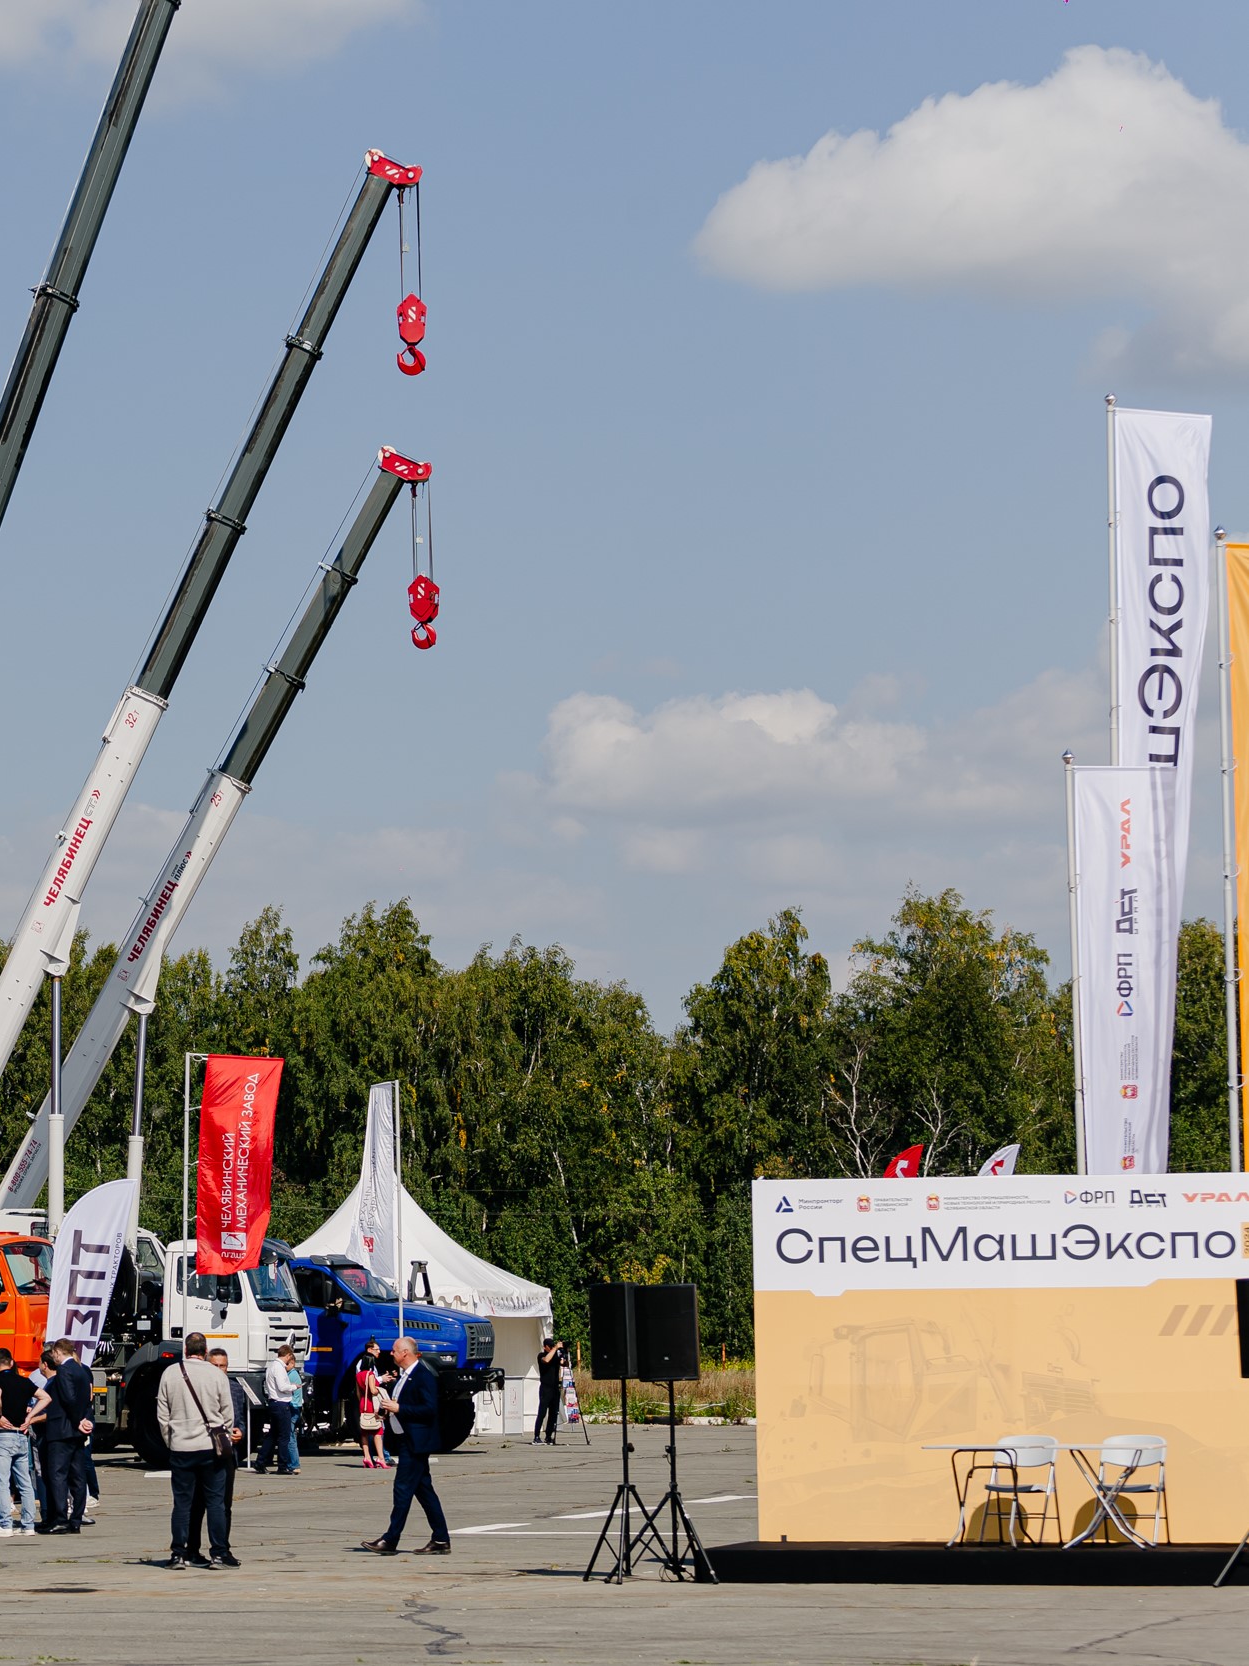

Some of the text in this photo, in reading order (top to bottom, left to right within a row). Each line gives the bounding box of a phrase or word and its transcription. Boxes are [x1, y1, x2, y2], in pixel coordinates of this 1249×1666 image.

[43, 817, 93, 907] ЧЕЛЯБИНЕЦ
[1120, 798, 1131, 869] УРАЛ
[127, 880, 179, 962] ЧЕЛЯБИНЕЦ
[1116, 953, 1134, 998] ФРП
[7, 1139, 38, 1193] 8-800-555-74-74
[221, 1132, 236, 1228] ЧЕЛЯБИНСКИЙ
[235, 1073, 260, 1229] МЕХАНИЧЕСКИЙ ЗАВОД
[1079, 1190, 1115, 1205] ФРП
[110, 1232, 123, 1280] ТРАКТОРОВ
[775, 1224, 1237, 1268] СпецМашЭкспо
